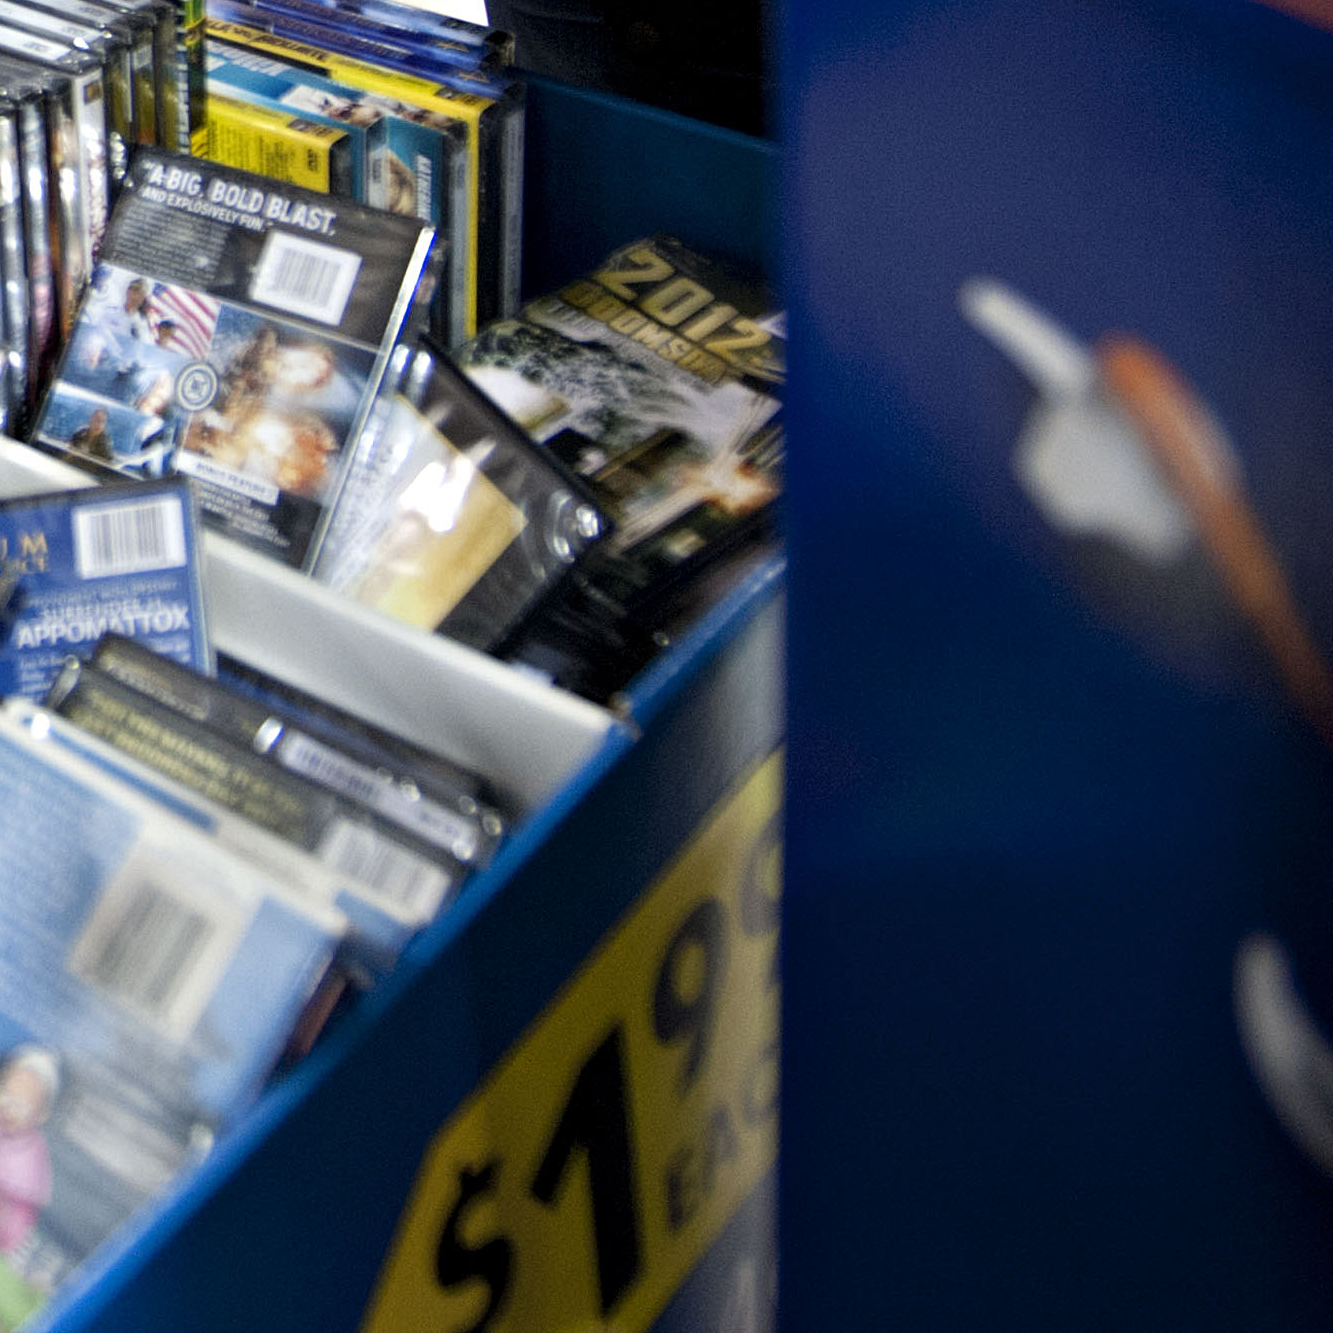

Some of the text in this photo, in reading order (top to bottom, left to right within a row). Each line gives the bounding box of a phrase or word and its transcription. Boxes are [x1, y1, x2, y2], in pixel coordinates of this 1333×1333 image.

[142, 187, 168, 204] AND
[168, 191, 239, 225] EXPLOSIVELY
[210, 177, 265, 215] BOLD
[593, 248, 773, 359] 2012
[15, 604, 192, 651] APPOMATTOX
[663, 1031, 780, 1241] EAC
